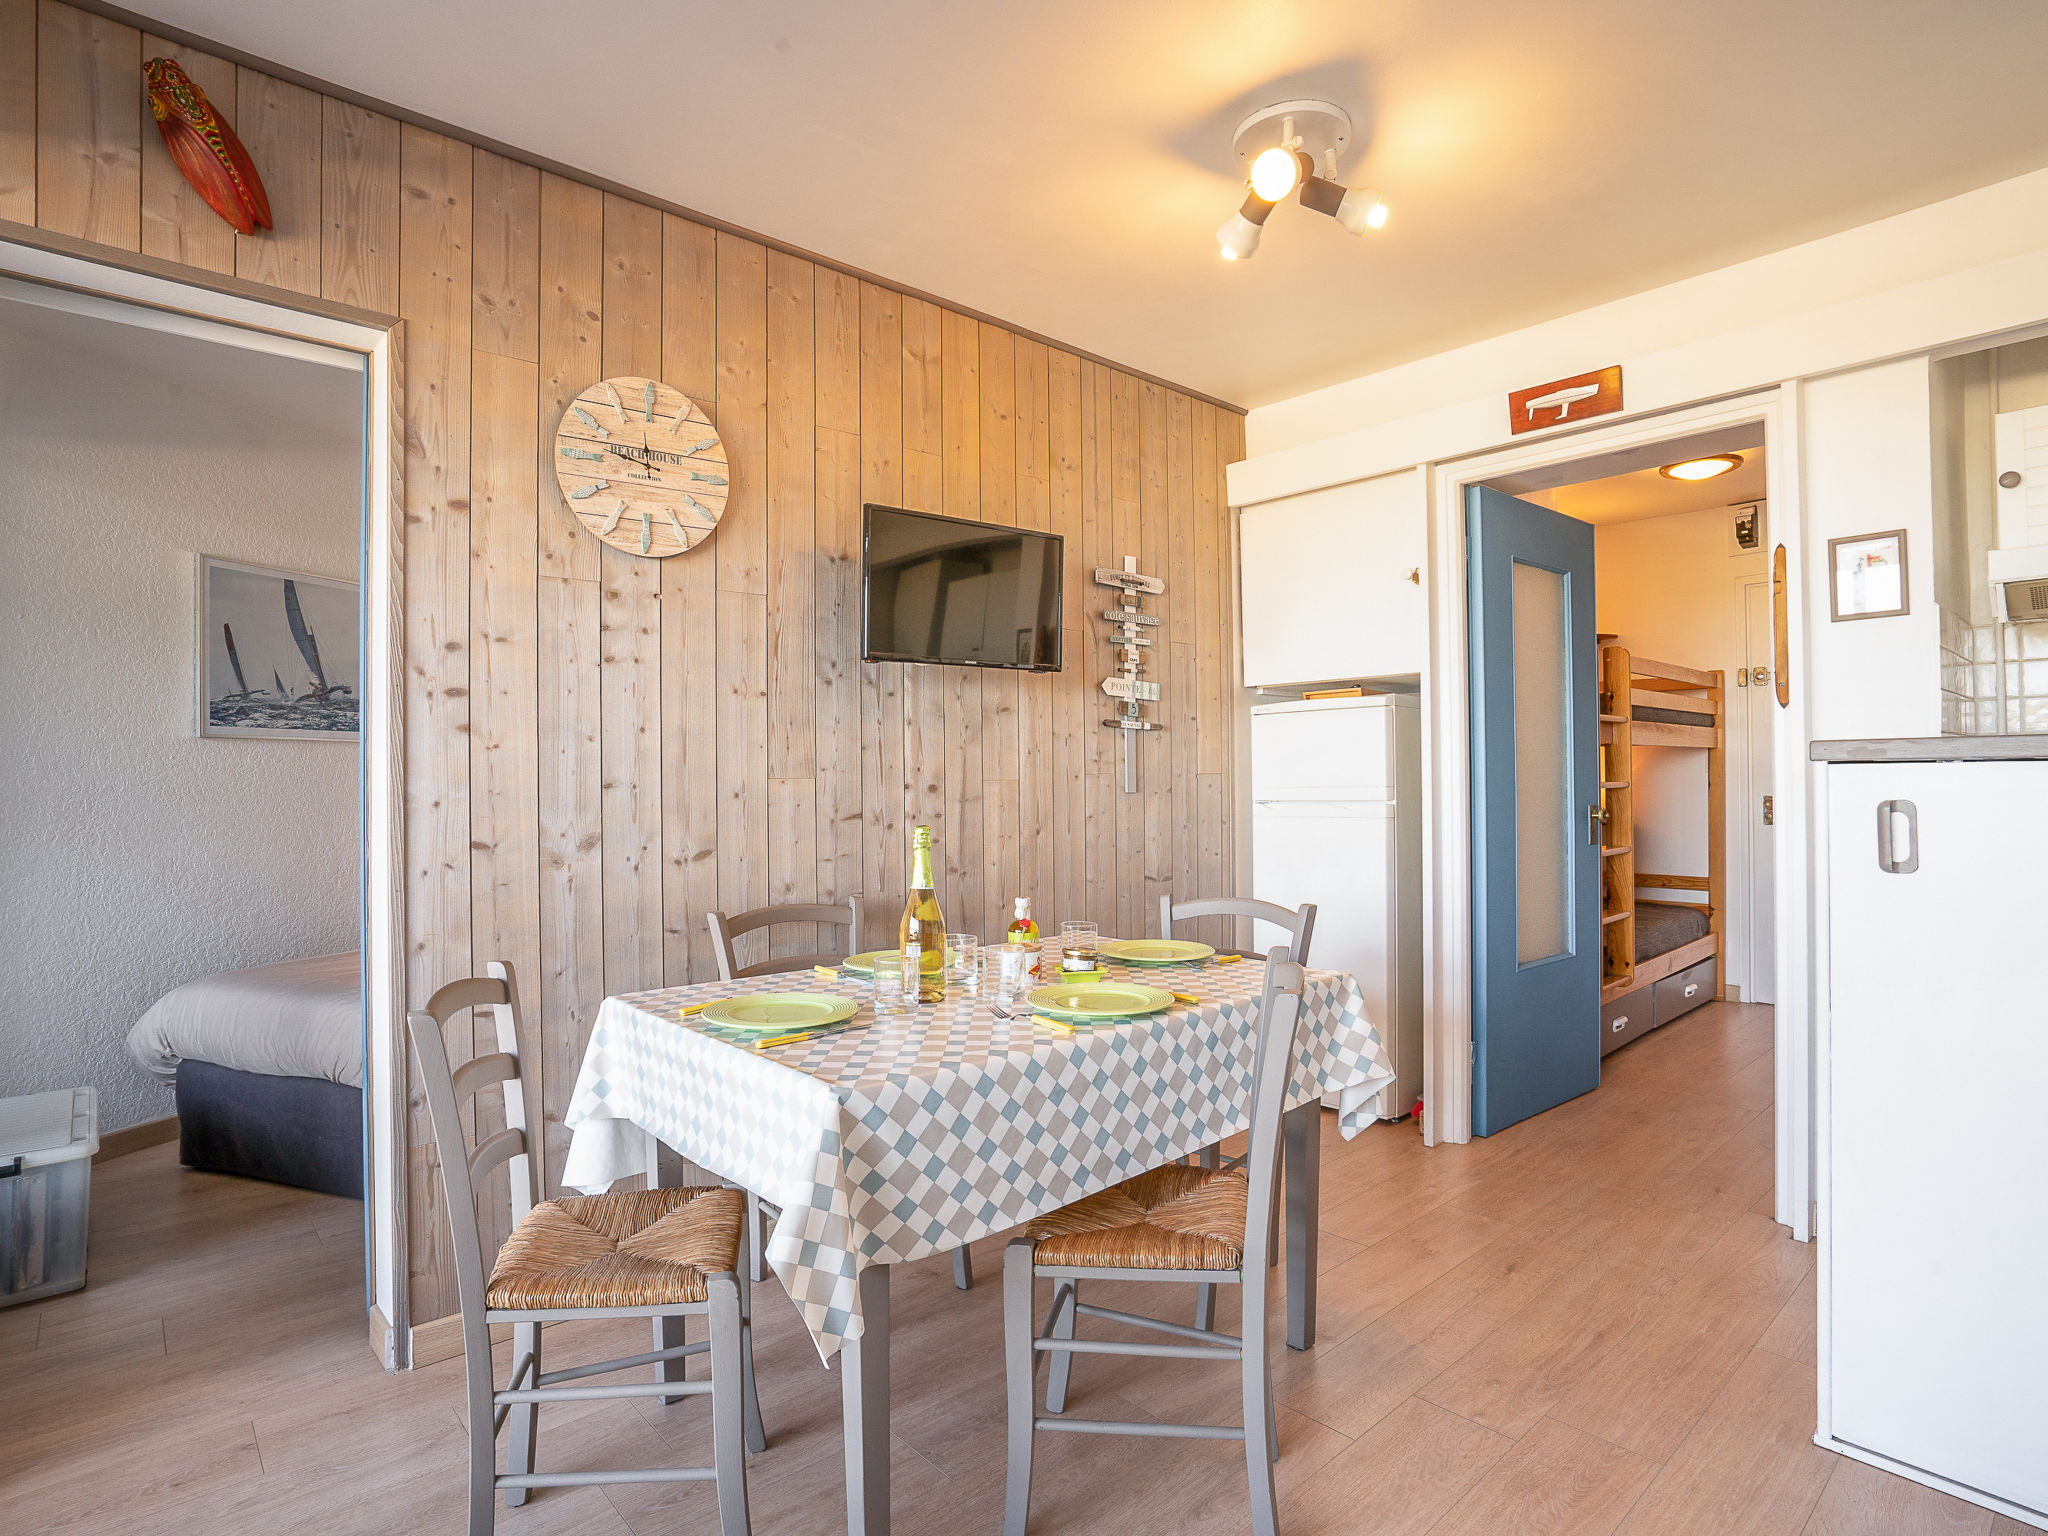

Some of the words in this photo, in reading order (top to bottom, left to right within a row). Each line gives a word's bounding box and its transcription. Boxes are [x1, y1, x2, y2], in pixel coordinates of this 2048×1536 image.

[610, 444, 645, 460] BEACH
[648, 450, 683, 466] HOUSE
[1125, 613, 1160, 625] sauvage
[1110, 681, 1141, 694] POINTE
[1131, 704, 1137, 715] 5
